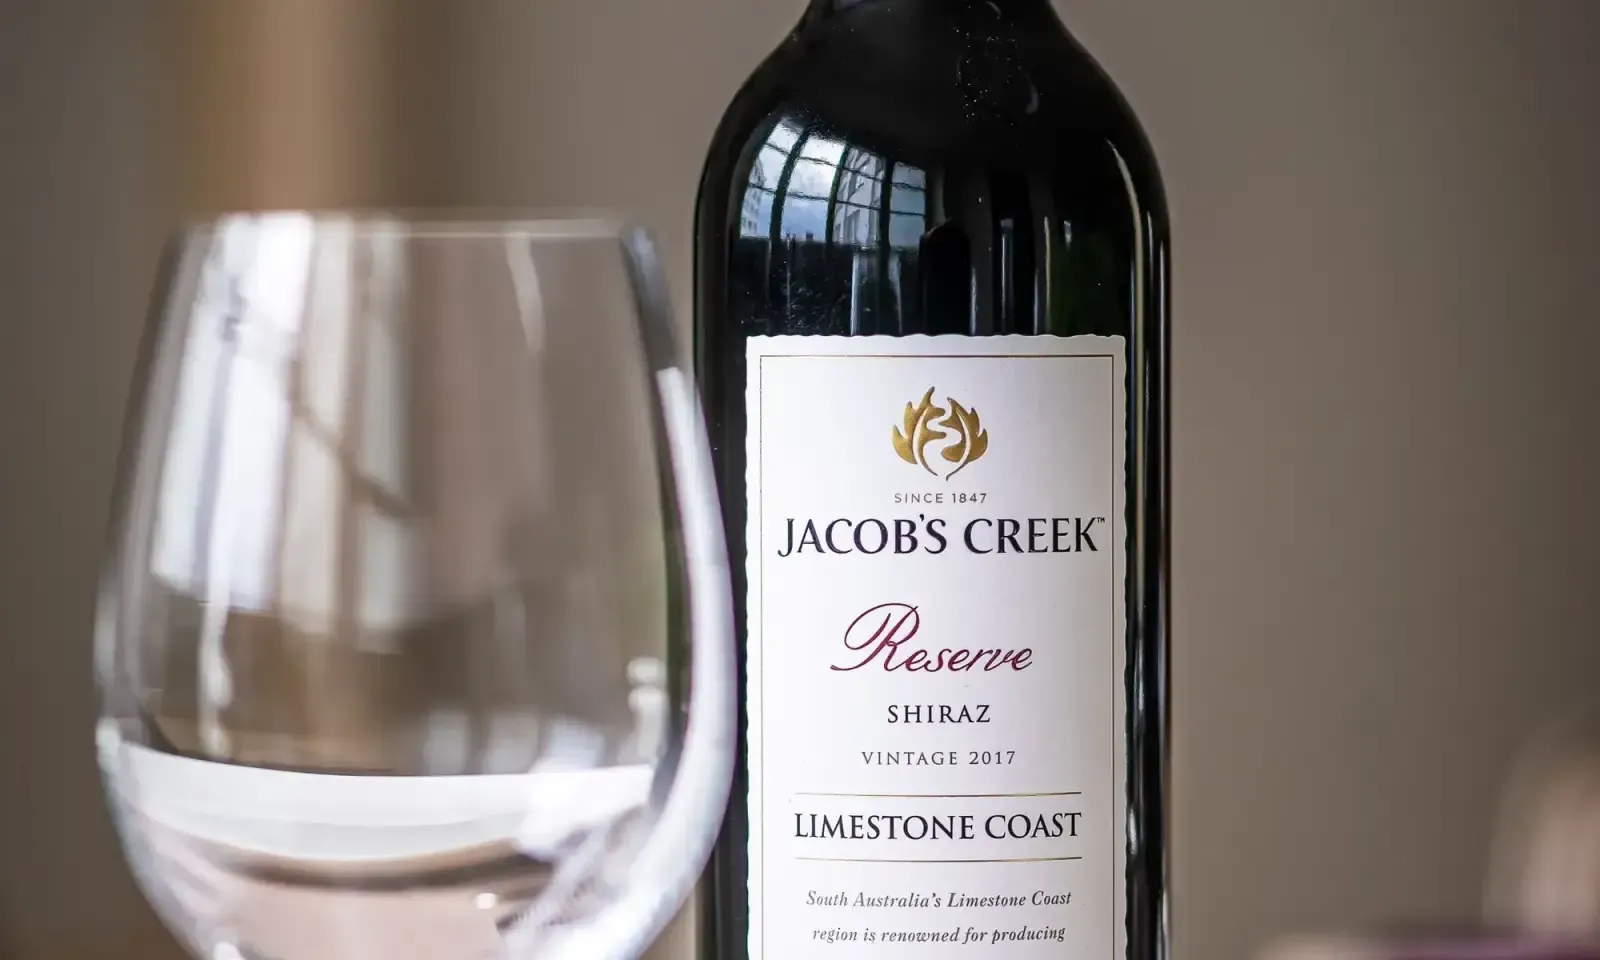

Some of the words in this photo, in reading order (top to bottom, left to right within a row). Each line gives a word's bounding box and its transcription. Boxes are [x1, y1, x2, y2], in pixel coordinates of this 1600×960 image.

[894, 492, 944, 504] SINCE
[951, 492, 988, 504] 1847
[777, 513, 948, 558] JACOB'S
[829, 602, 1033, 673] Reserve
[887, 704, 991, 724] SHIRAZ
[861, 751, 958, 766] VINTAGE
[968, 750, 1016, 765] 2017
[794, 812, 975, 841] LIMESTONE
[984, 811, 1082, 840] COAST
[805, 890, 848, 908] South
[852, 891, 942, 909] Australia's
[946, 892, 1027, 908] Limestone
[1031, 890, 1072, 906] Coast
[812, 927, 858, 944] region
[863, 927, 876, 942] is
[881, 926, 960, 943] renowned
[962, 926, 988, 945] for
[991, 925, 1066, 944] producing
